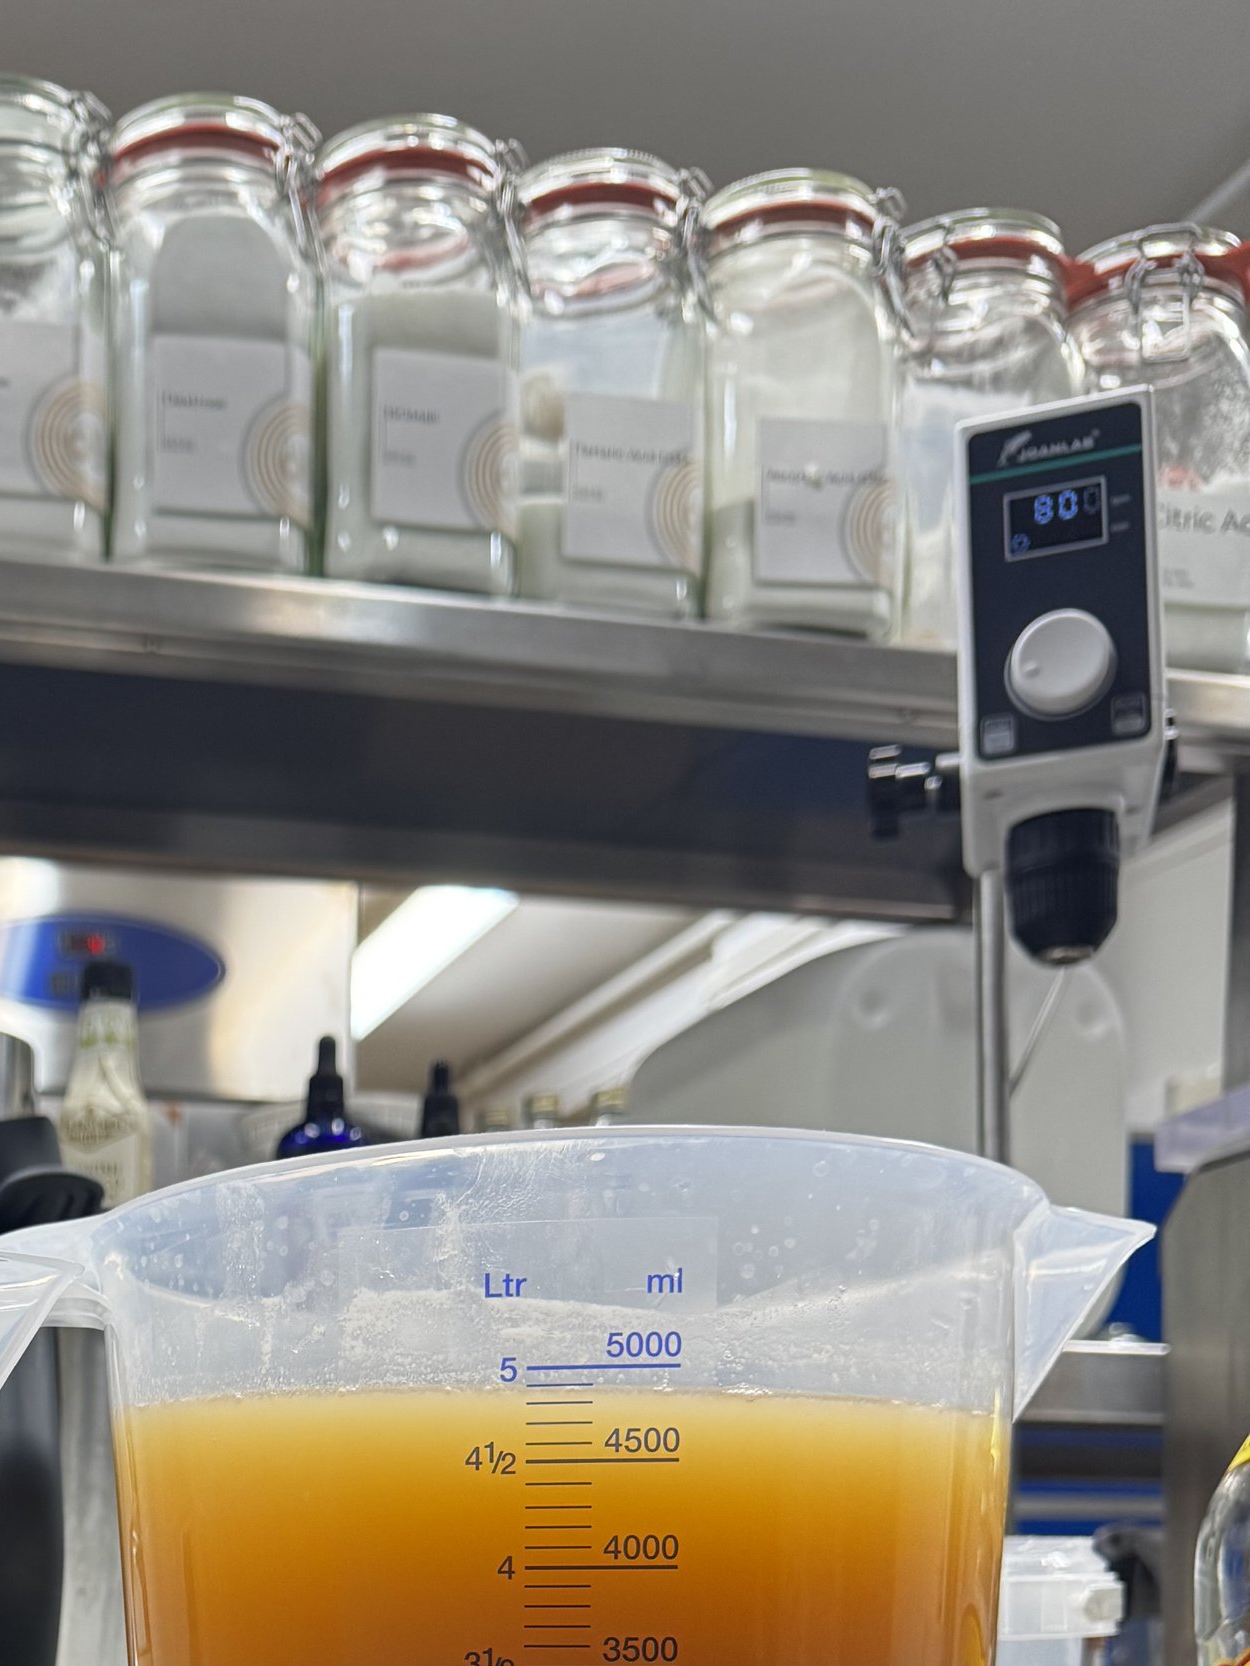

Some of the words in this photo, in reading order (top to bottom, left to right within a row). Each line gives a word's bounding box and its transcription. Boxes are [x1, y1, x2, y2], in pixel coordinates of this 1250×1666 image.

[485, 1273, 527, 1298] Ltr
[647, 1267, 682, 1293] ml
[606, 1331, 682, 1358] 5000
[500, 1357, 518, 1382] 5
[604, 1427, 680, 1453] 4500
[603, 1534, 679, 1560] 4000
[497, 1555, 516, 1580] 4
[602, 1636, 678, 1662] 3500
